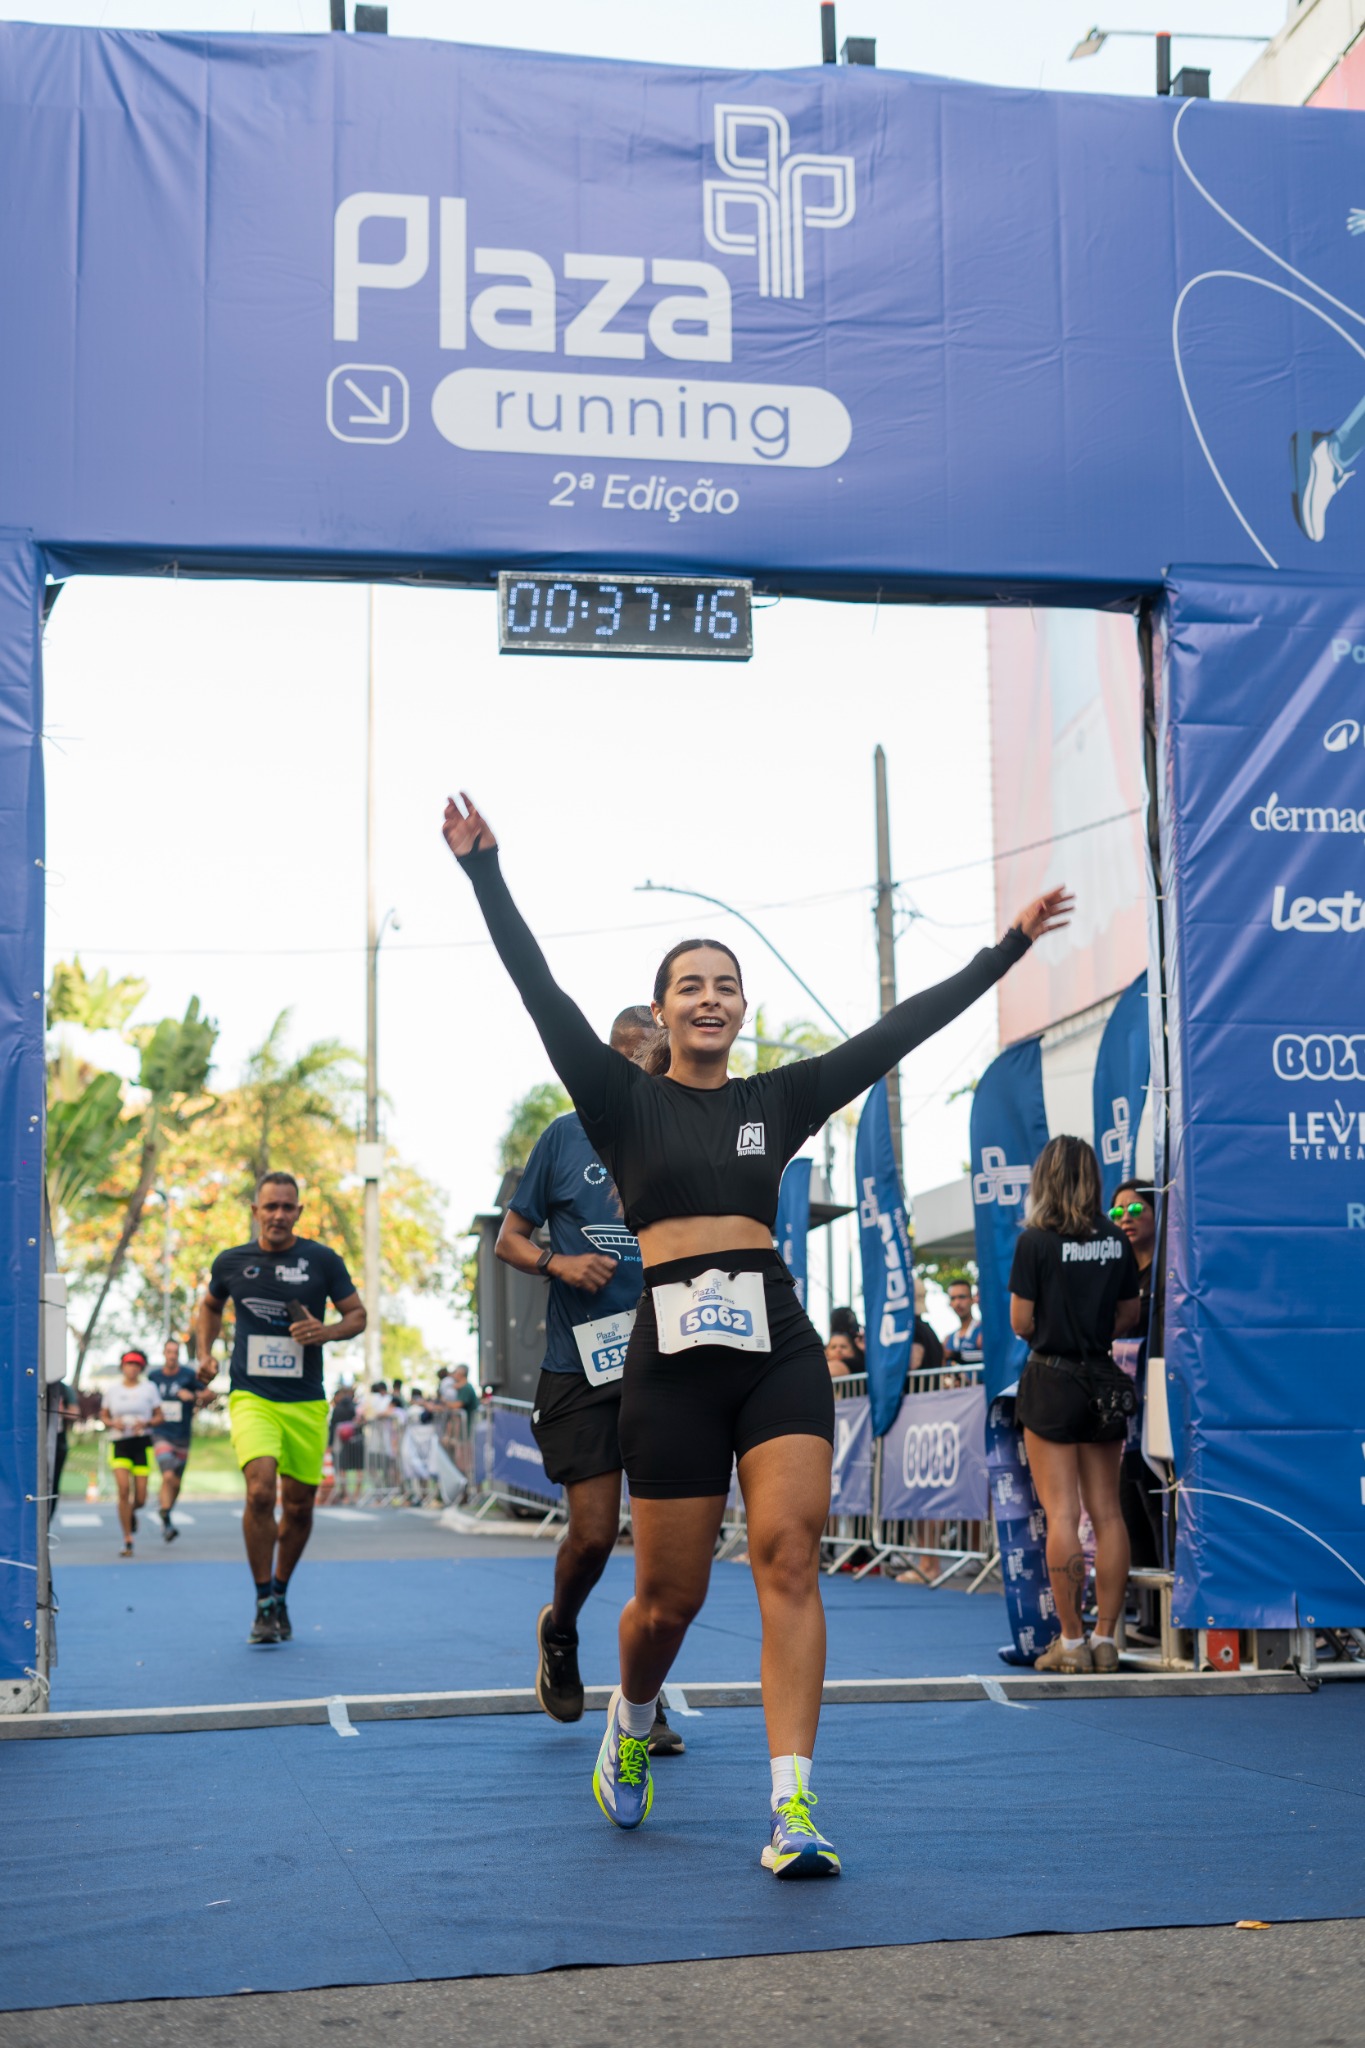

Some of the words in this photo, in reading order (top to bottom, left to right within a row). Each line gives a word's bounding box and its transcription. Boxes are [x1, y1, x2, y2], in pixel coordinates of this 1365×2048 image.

[334, 192, 732, 362] Plaza
[496, 386, 789, 460] running
[602, 475, 739, 522] Edição
[507, 582, 738, 640] 00:37:16
[686, 1306, 747, 1332] 5062
